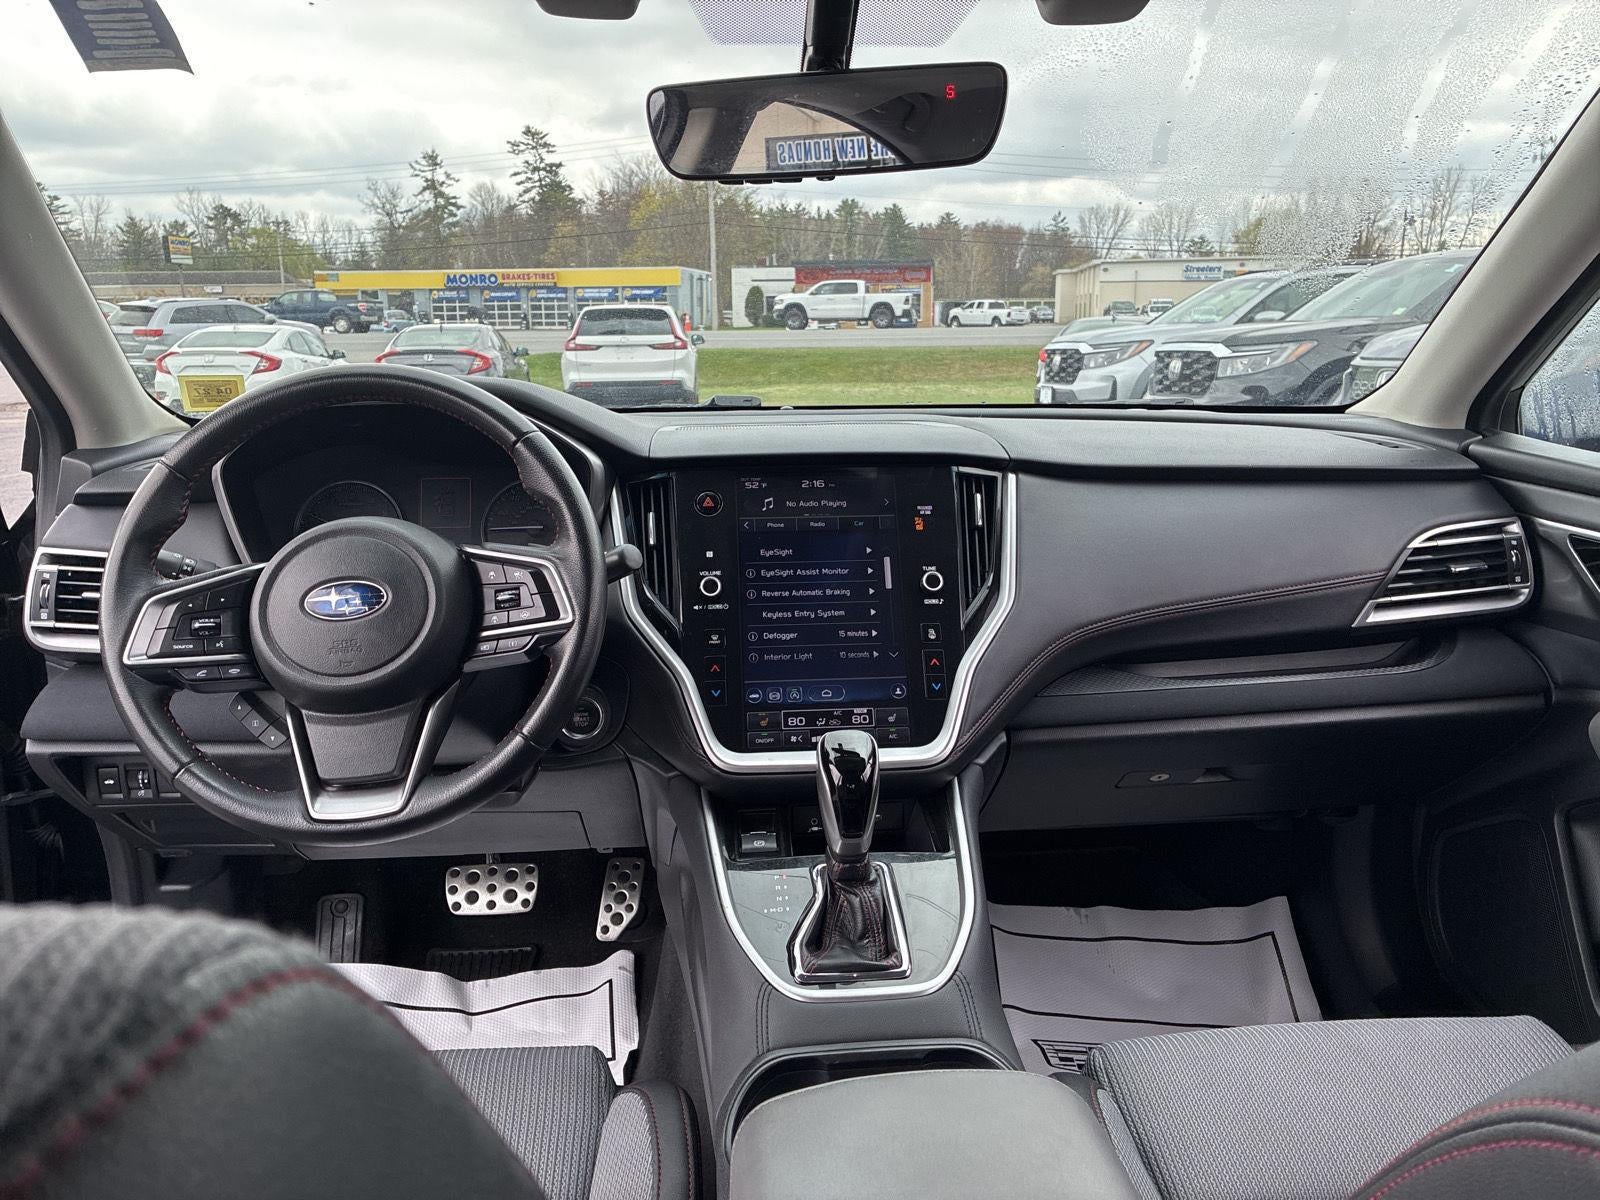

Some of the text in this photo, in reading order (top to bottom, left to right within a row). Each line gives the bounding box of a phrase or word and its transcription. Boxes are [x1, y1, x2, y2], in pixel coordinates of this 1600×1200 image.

[445, 272, 499, 287] MONRO
[801, 479, 825, 488] 2:16
[786, 499, 847, 508] No Audio Playing
[760, 548, 793, 557] EyeSight
[761, 567, 850, 578] EyeSight Assist Monitor
[791, 588, 824, 596] Automatic
[825, 588, 851, 597] Braking
[762, 608, 846, 620] Keyless Entry System
[763, 632, 798, 641] Defogger
[838, 629, 869, 638] 15 minutes
[764, 652, 813, 661] Interior Light
[848, 651, 870, 659] seconds
[787, 716, 806, 726] 80
[851, 714, 869, 724] 80
